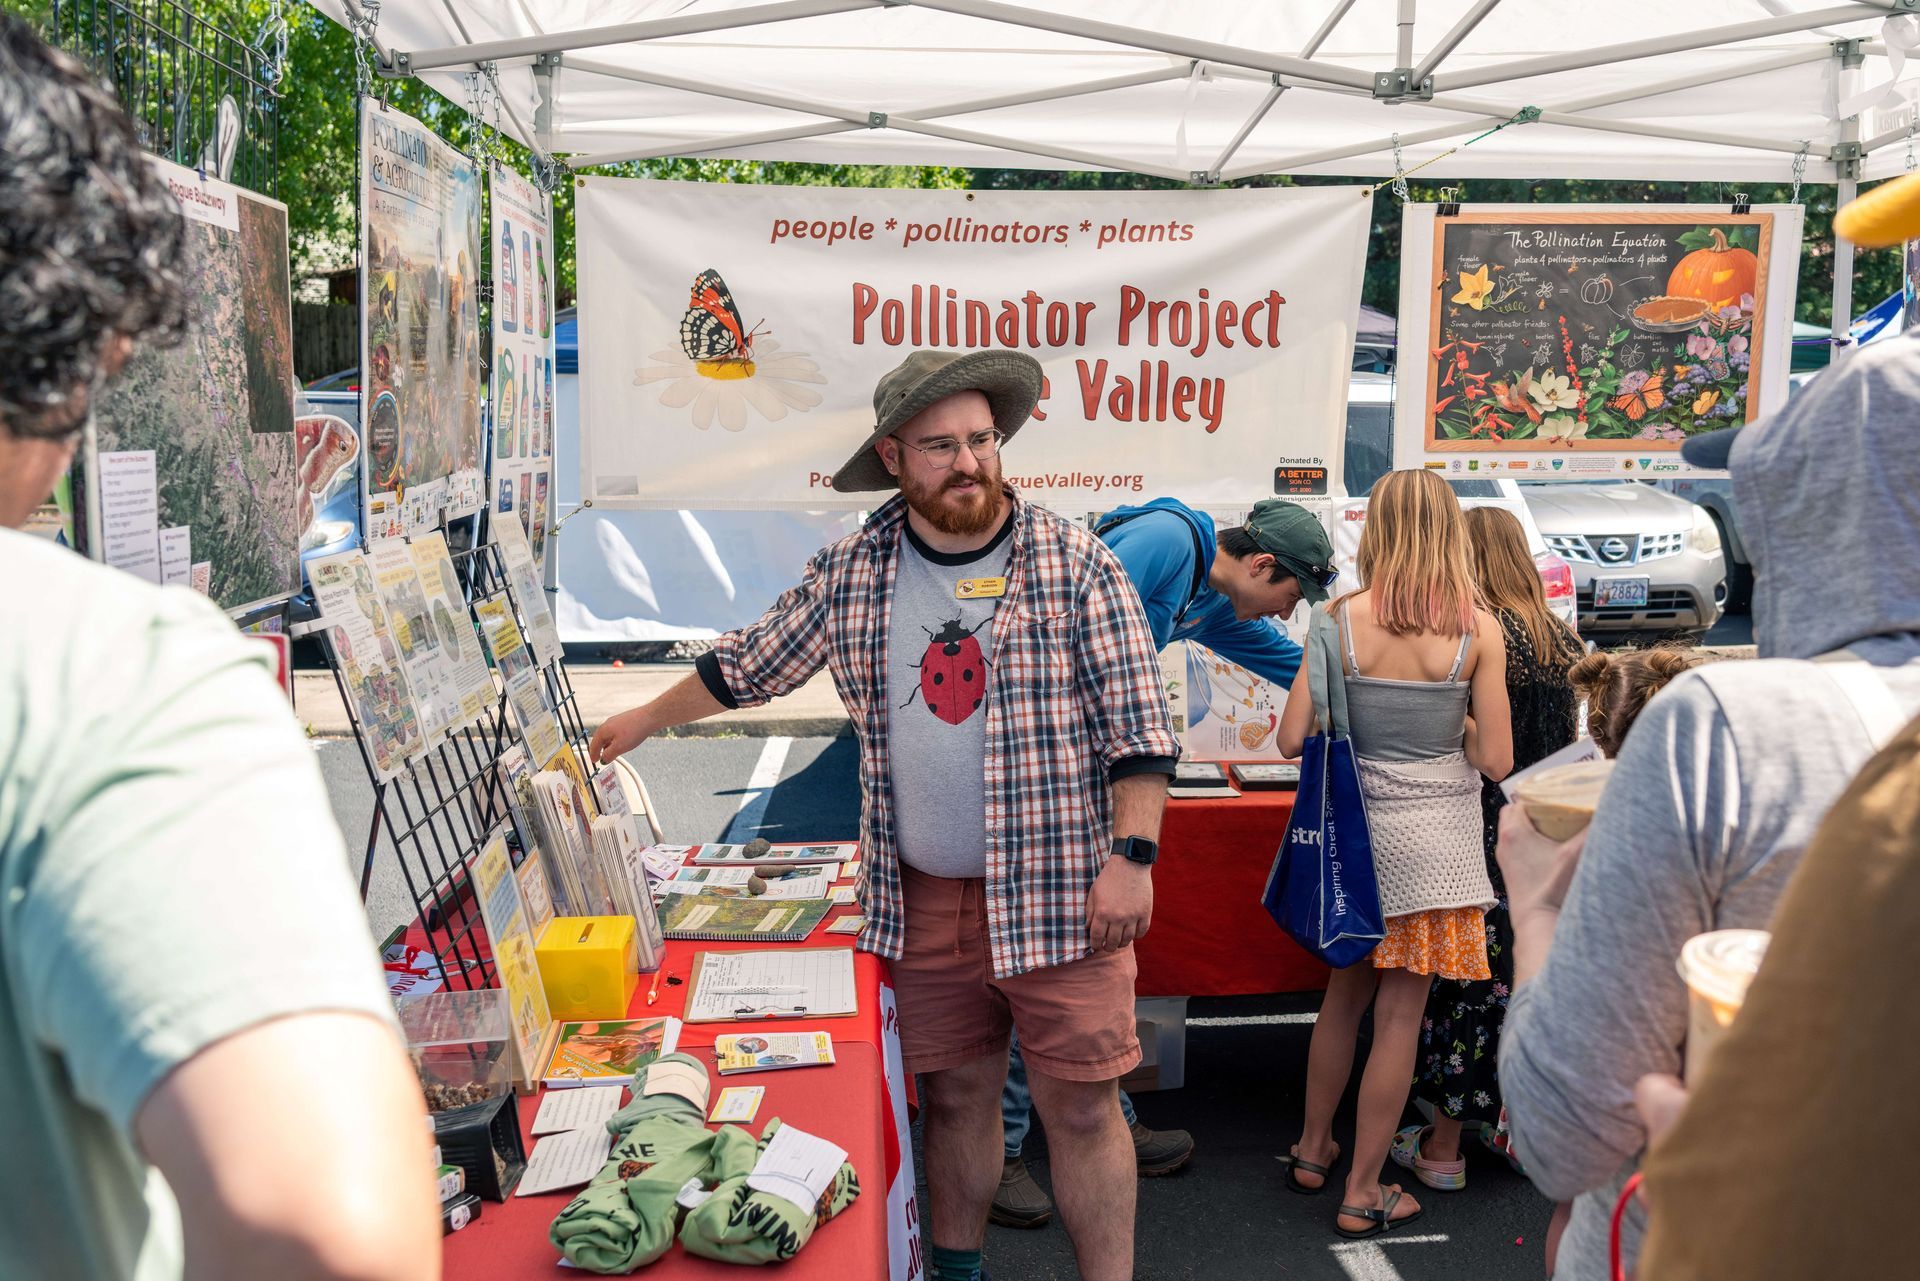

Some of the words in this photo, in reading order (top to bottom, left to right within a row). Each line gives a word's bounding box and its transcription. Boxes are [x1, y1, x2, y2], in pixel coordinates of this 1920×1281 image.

[371, 117, 434, 172] POLLINATO
[372, 154, 384, 182] &
[168, 177, 194, 205] Rogue
[770, 216, 875, 245] people
[903, 217, 1069, 246] pollinators
[1097, 219, 1194, 249] plants
[1504, 230, 1532, 249] The
[1532, 230, 1604, 248] Pollination
[1611, 230, 1668, 256] Equation
[1514, 254, 1538, 267] plants
[1548, 250, 1588, 267] pollinators
[1593, 251, 1634, 267] pollinators
[1647, 253, 1668, 267] plants
[852, 282, 1096, 349] Pollinator
[1118, 285, 1287, 358] Project
[1450, 320, 1469, 328] Some
[1471, 320, 1488, 328] other
[1491, 320, 1521, 329] pollinator
[1075, 357, 1226, 434] Valley
[1279, 456, 1312, 464] Donated
[1312, 456, 1323, 465] By
[1279, 470, 1286, 478] A
[1288, 470, 1324, 478] BETTER
[1328, 820, 1338, 858] Great
[1331, 860, 1347, 917] Inspiring
